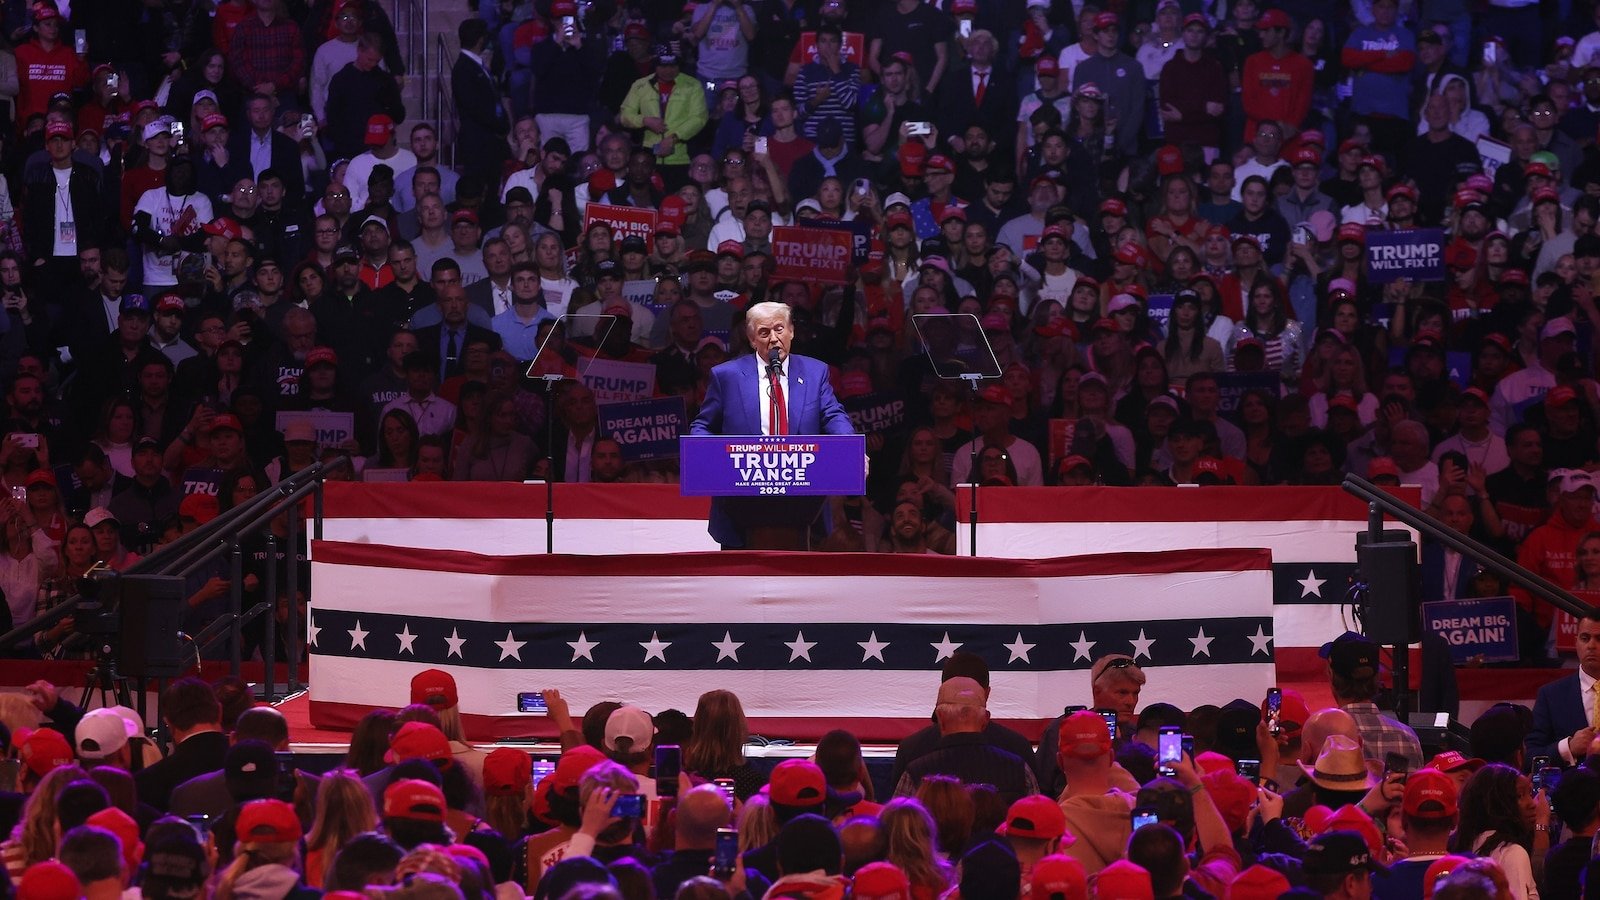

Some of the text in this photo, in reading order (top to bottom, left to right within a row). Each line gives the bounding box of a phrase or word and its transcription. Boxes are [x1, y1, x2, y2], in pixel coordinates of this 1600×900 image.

[1362, 40, 1399, 51] TRUMP
[630, 222, 653, 233] BIG,
[776, 241, 848, 259] TRUMP
[855, 248, 867, 257] IT
[1369, 243, 1440, 260] TRUMP
[776, 255, 847, 271] WILL FIX IT
[1371, 257, 1440, 270] WILL FIX IT
[1148, 308, 1171, 317] DRE
[280, 383, 300, 395] 20
[583, 374, 647, 393] TRUMP
[613, 392, 630, 402] FIX
[849, 400, 904, 425] RUMP
[607, 414, 681, 430] DREAM BIG,
[872, 420, 891, 432] FIX
[613, 425, 677, 445] AGAIN!
[730, 444, 815, 453] TRUMP WILL FIX IT
[730, 453, 816, 469] TRUMP
[1199, 461, 1218, 471] USA
[740, 468, 806, 481] VANCE
[184, 480, 220, 497] TRU
[759, 487, 787, 495] 2024
[1431, 615, 1510, 630] DREAM BIG,
